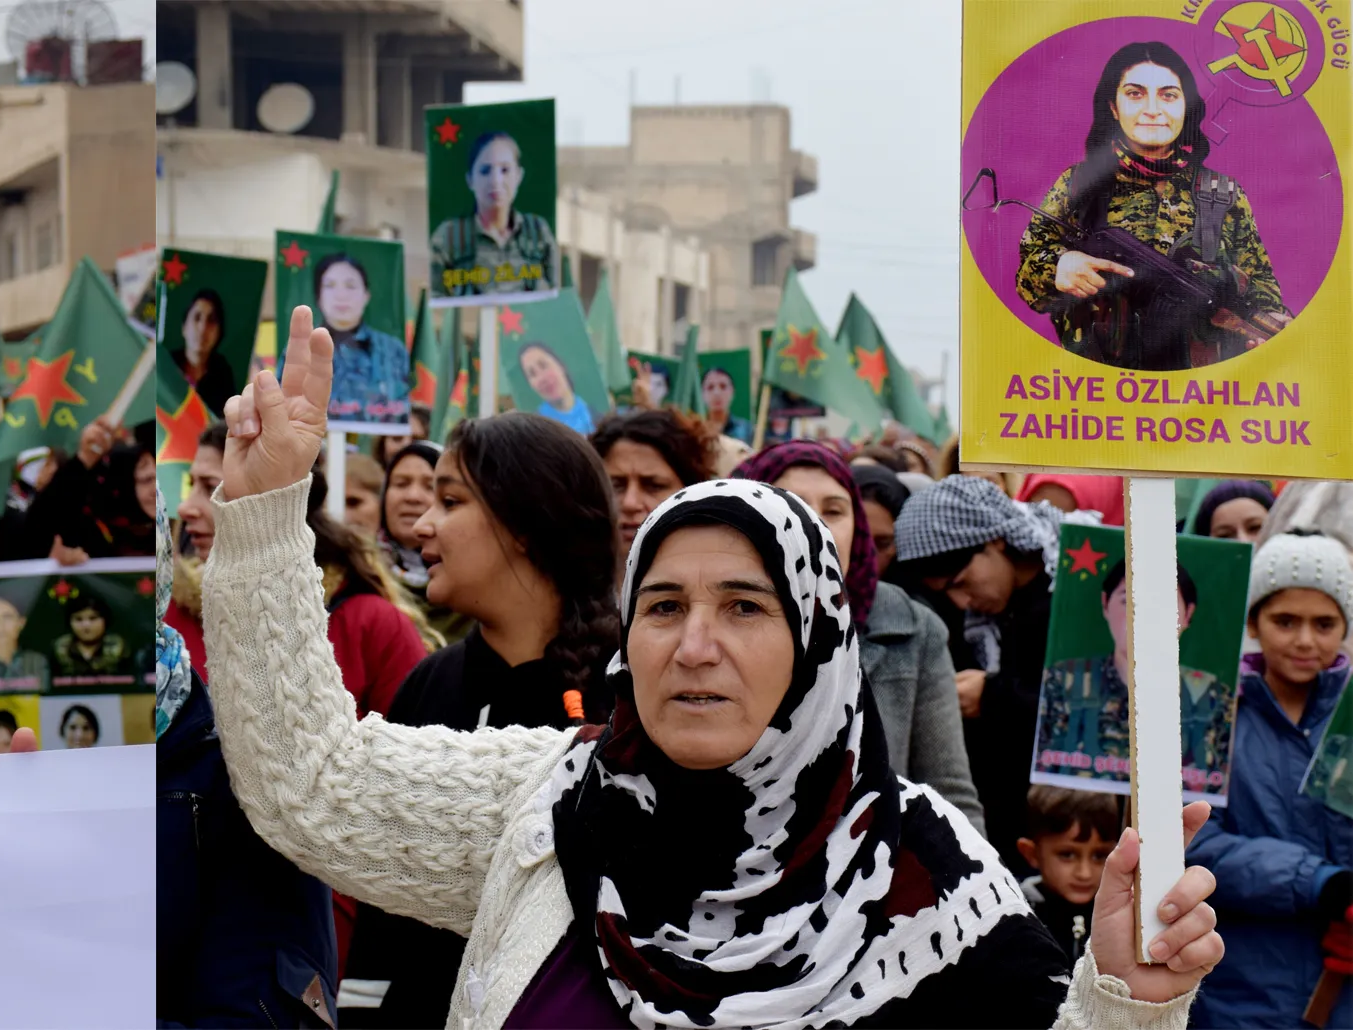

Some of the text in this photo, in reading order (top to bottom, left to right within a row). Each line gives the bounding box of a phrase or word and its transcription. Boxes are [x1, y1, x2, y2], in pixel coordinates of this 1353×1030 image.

[1327, 16, 1350, 69] GÜCÜ
[1004, 369, 1300, 407] ASİYE ÖZLAHLAN
[999, 408, 1313, 446] ZAHİDE ROSA SUK
